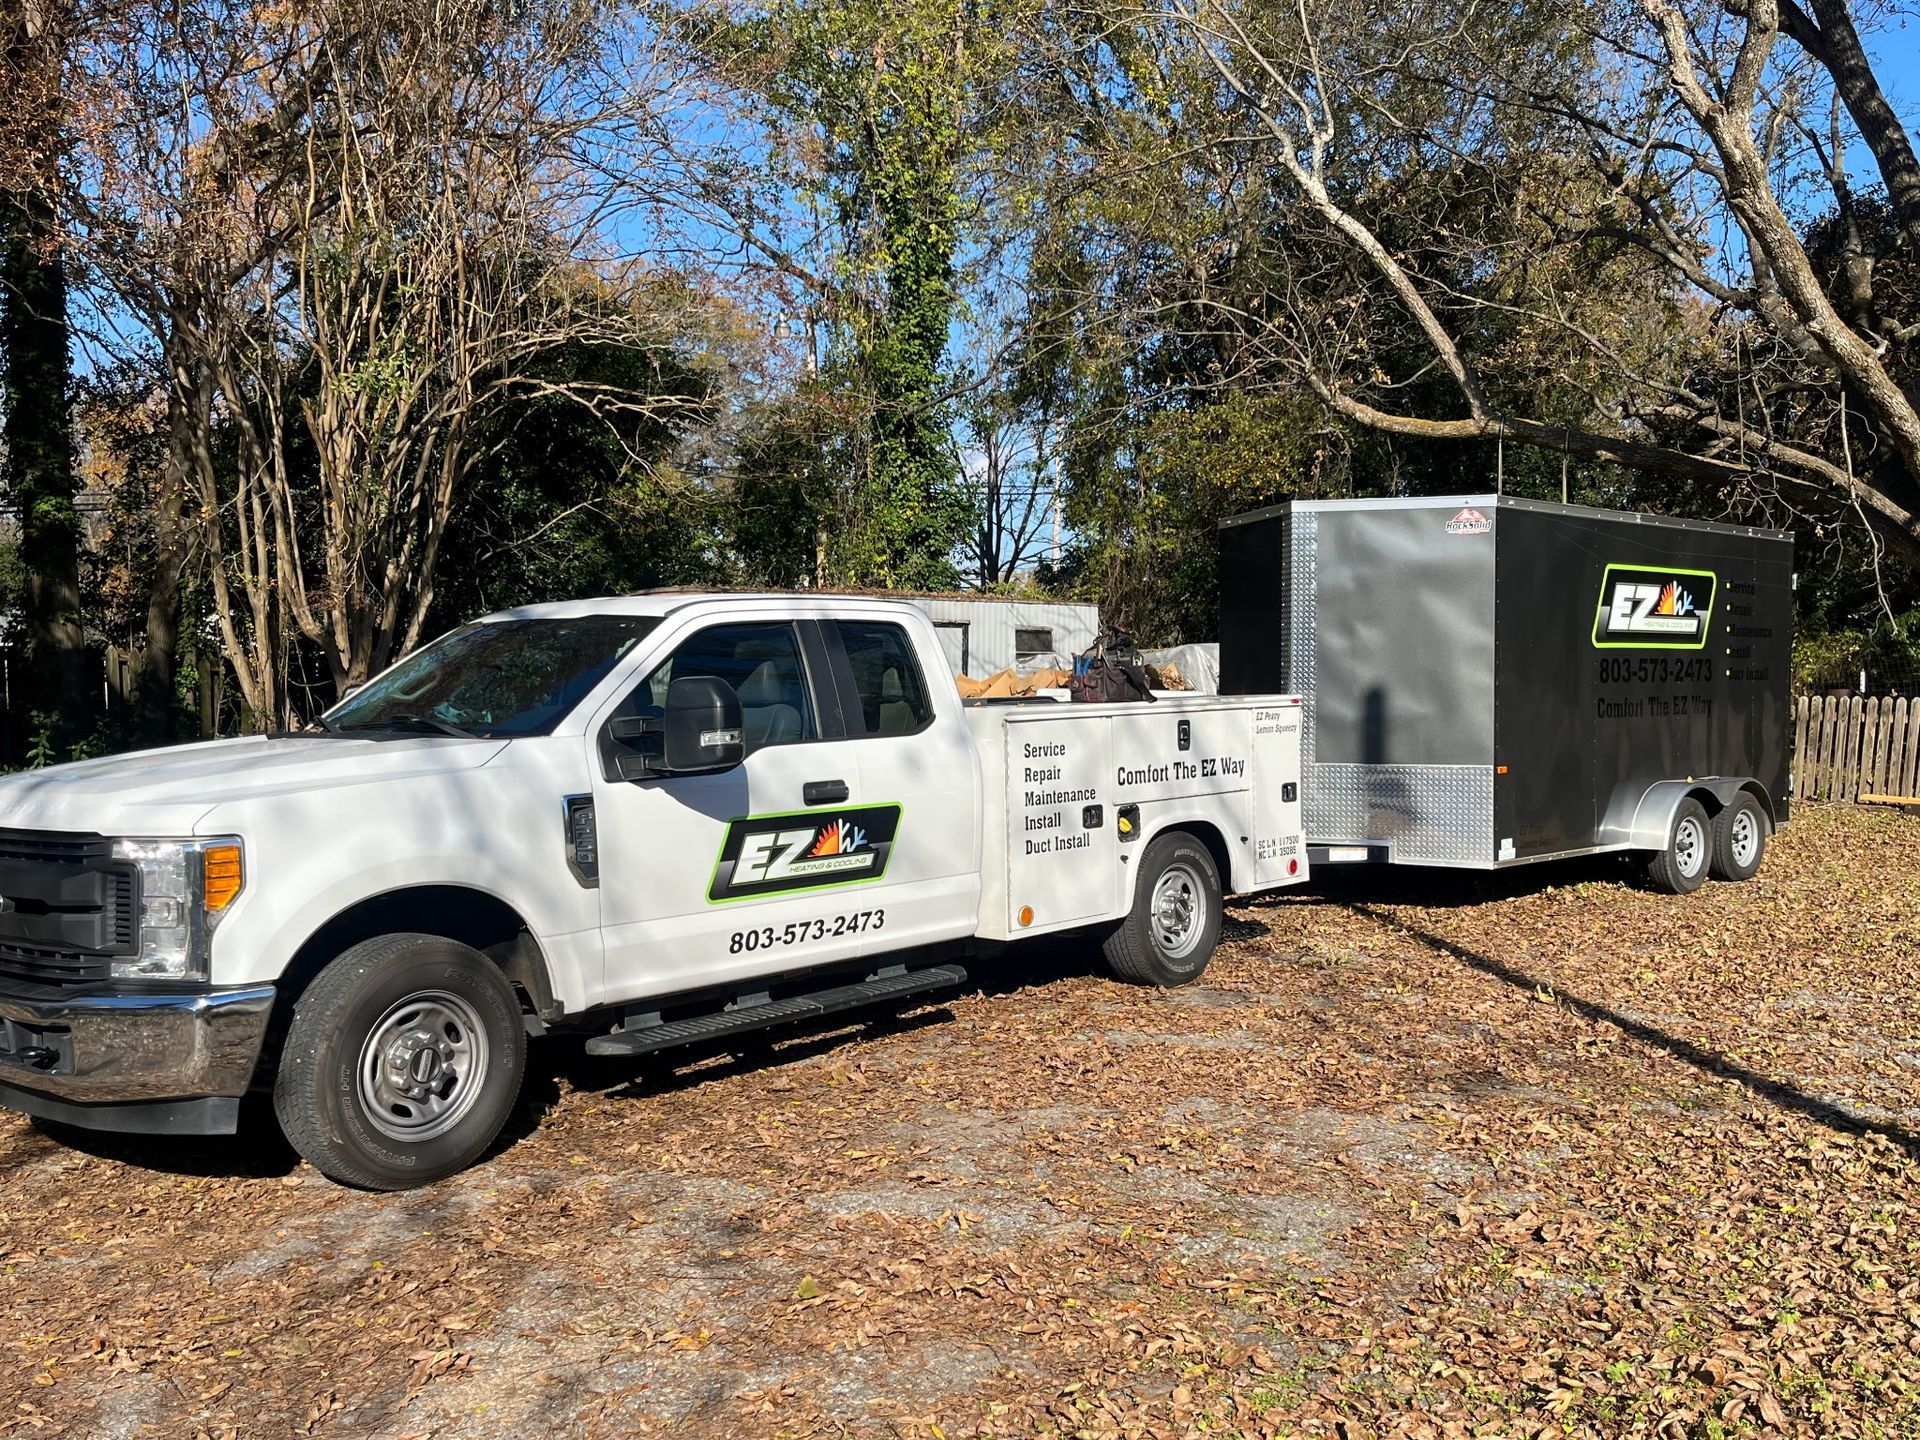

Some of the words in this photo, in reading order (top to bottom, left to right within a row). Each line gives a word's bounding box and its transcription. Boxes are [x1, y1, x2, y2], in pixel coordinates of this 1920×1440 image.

[1607, 582, 1662, 632] EZ
[1600, 658, 1712, 683] 803-573-2473
[1597, 698, 1644, 719] Comfort
[1648, 697, 1669, 716] The
[1673, 696, 1688, 715] EZ
[1691, 694, 1712, 718] Way
[1256, 724, 1275, 735] Lemon
[1024, 742, 1066, 758] Service
[1024, 766, 1061, 785] Repair
[1117, 763, 1169, 786] Comfort
[1173, 761, 1197, 780] The
[1201, 759, 1217, 777] EZ
[1221, 757, 1245, 778] Way
[1024, 787, 1096, 807] Maintenance
[1025, 812, 1061, 831] Install
[1025, 838, 1051, 855] Duct
[1054, 832, 1090, 851] Install
[730, 828, 818, 888] EZ
[789, 863, 825, 873] HEATING
[833, 857, 867, 868] COOLING
[729, 909, 885, 955] 803-573-2473
